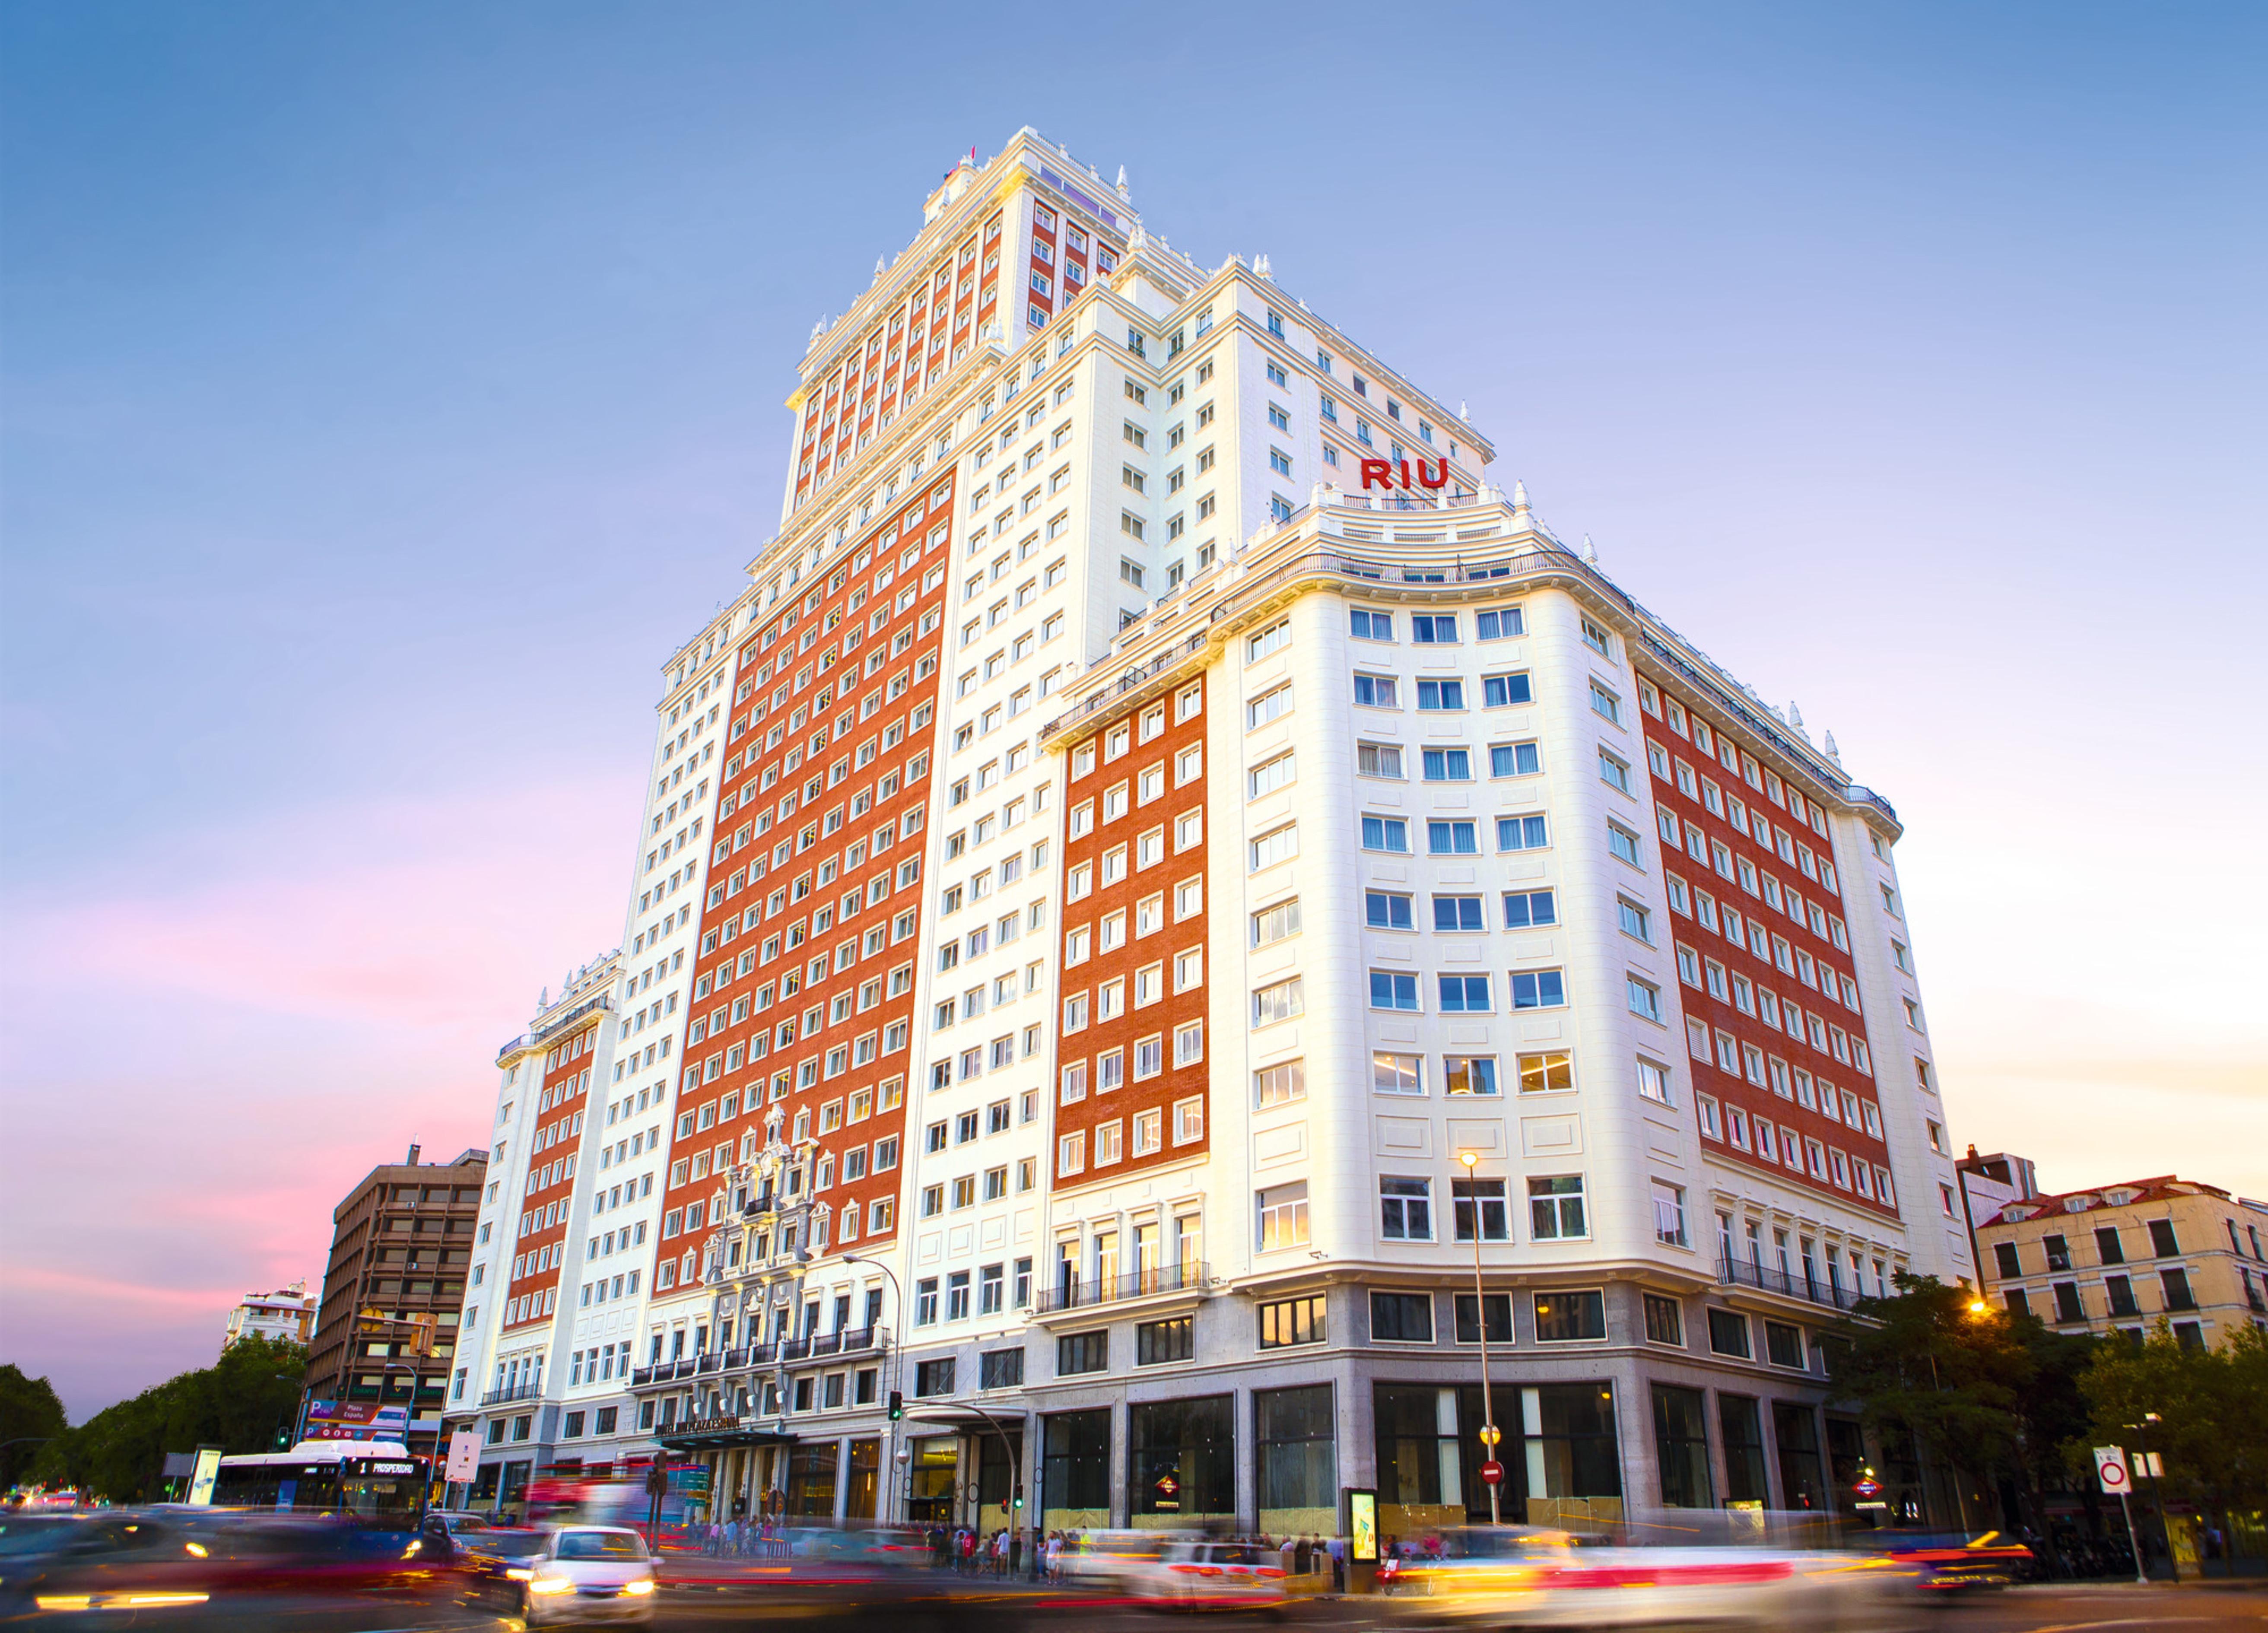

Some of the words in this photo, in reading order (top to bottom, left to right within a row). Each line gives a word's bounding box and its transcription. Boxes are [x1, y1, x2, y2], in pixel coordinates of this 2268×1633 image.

[1361, 457, 1448, 489] RIU
[311, 1401, 321, 1414] P
[307, 1427, 314, 1436] P
[360, 1462, 366, 1474] 1
[373, 1463, 414, 1474] PROSPERIDAD
